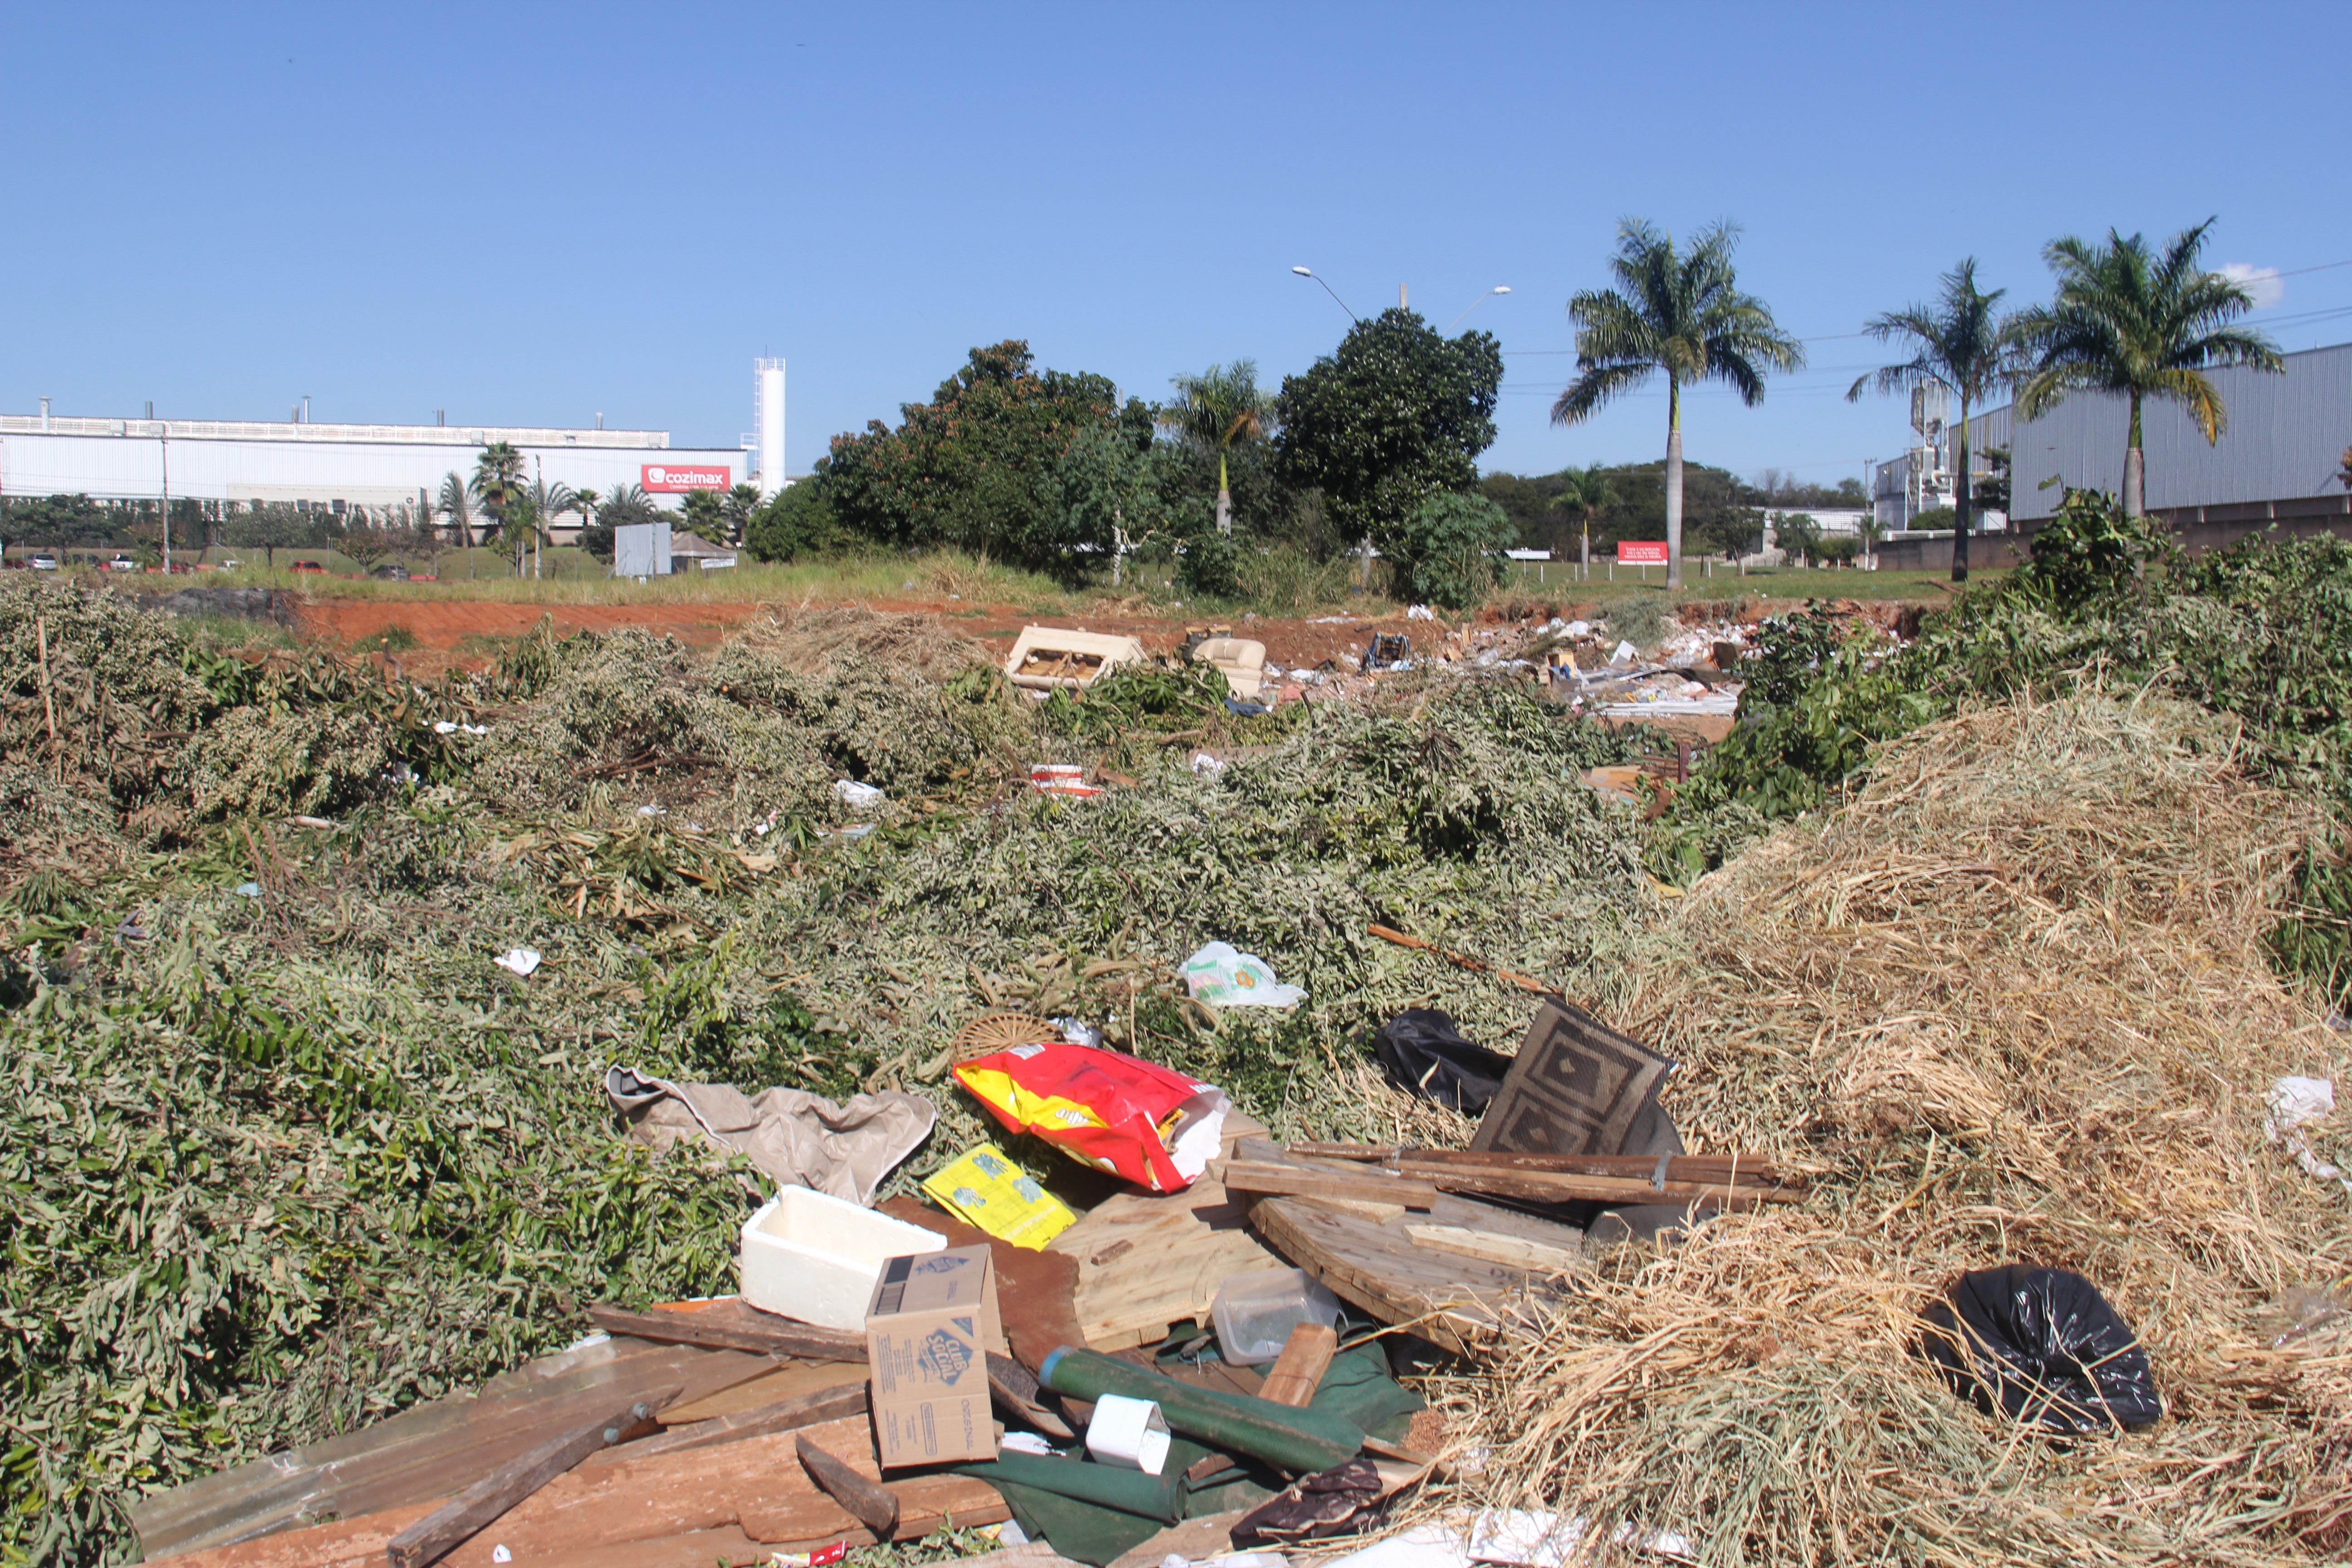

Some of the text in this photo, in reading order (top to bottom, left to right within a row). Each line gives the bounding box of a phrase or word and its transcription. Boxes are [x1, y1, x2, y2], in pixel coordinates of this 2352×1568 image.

[666, 470, 723, 485] cozimax
[945, 1339, 968, 1371] CLUB
[961, 1399, 974, 1451] ORIGINAL
